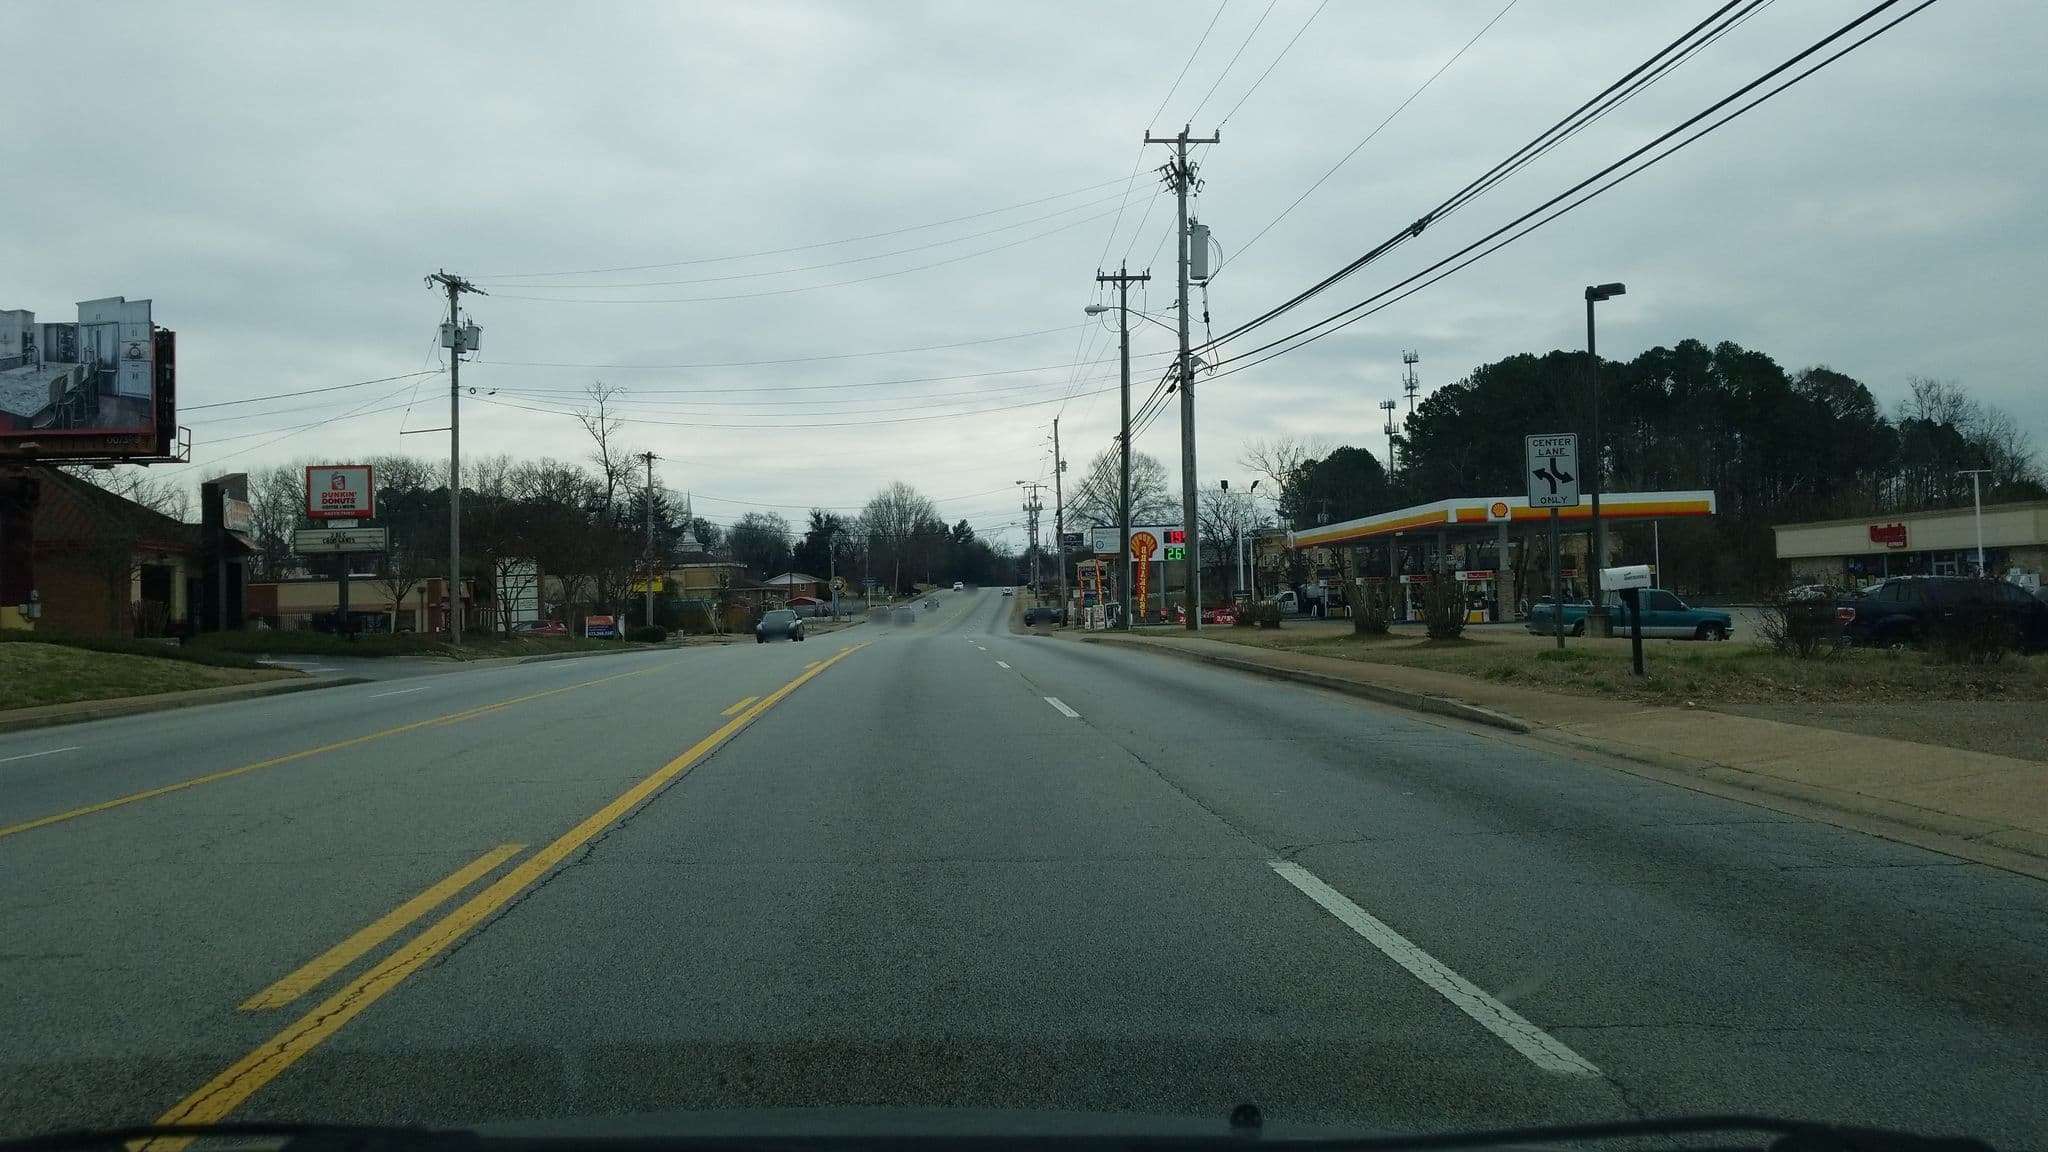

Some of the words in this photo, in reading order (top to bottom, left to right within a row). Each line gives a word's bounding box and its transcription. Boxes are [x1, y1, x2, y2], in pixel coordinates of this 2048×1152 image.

[1533, 438, 1571, 447] CENTER
[1538, 447, 1566, 455] LANE
[1540, 496, 1568, 504] ONLY
[1139, 546, 1147, 618] BREAKFAST
